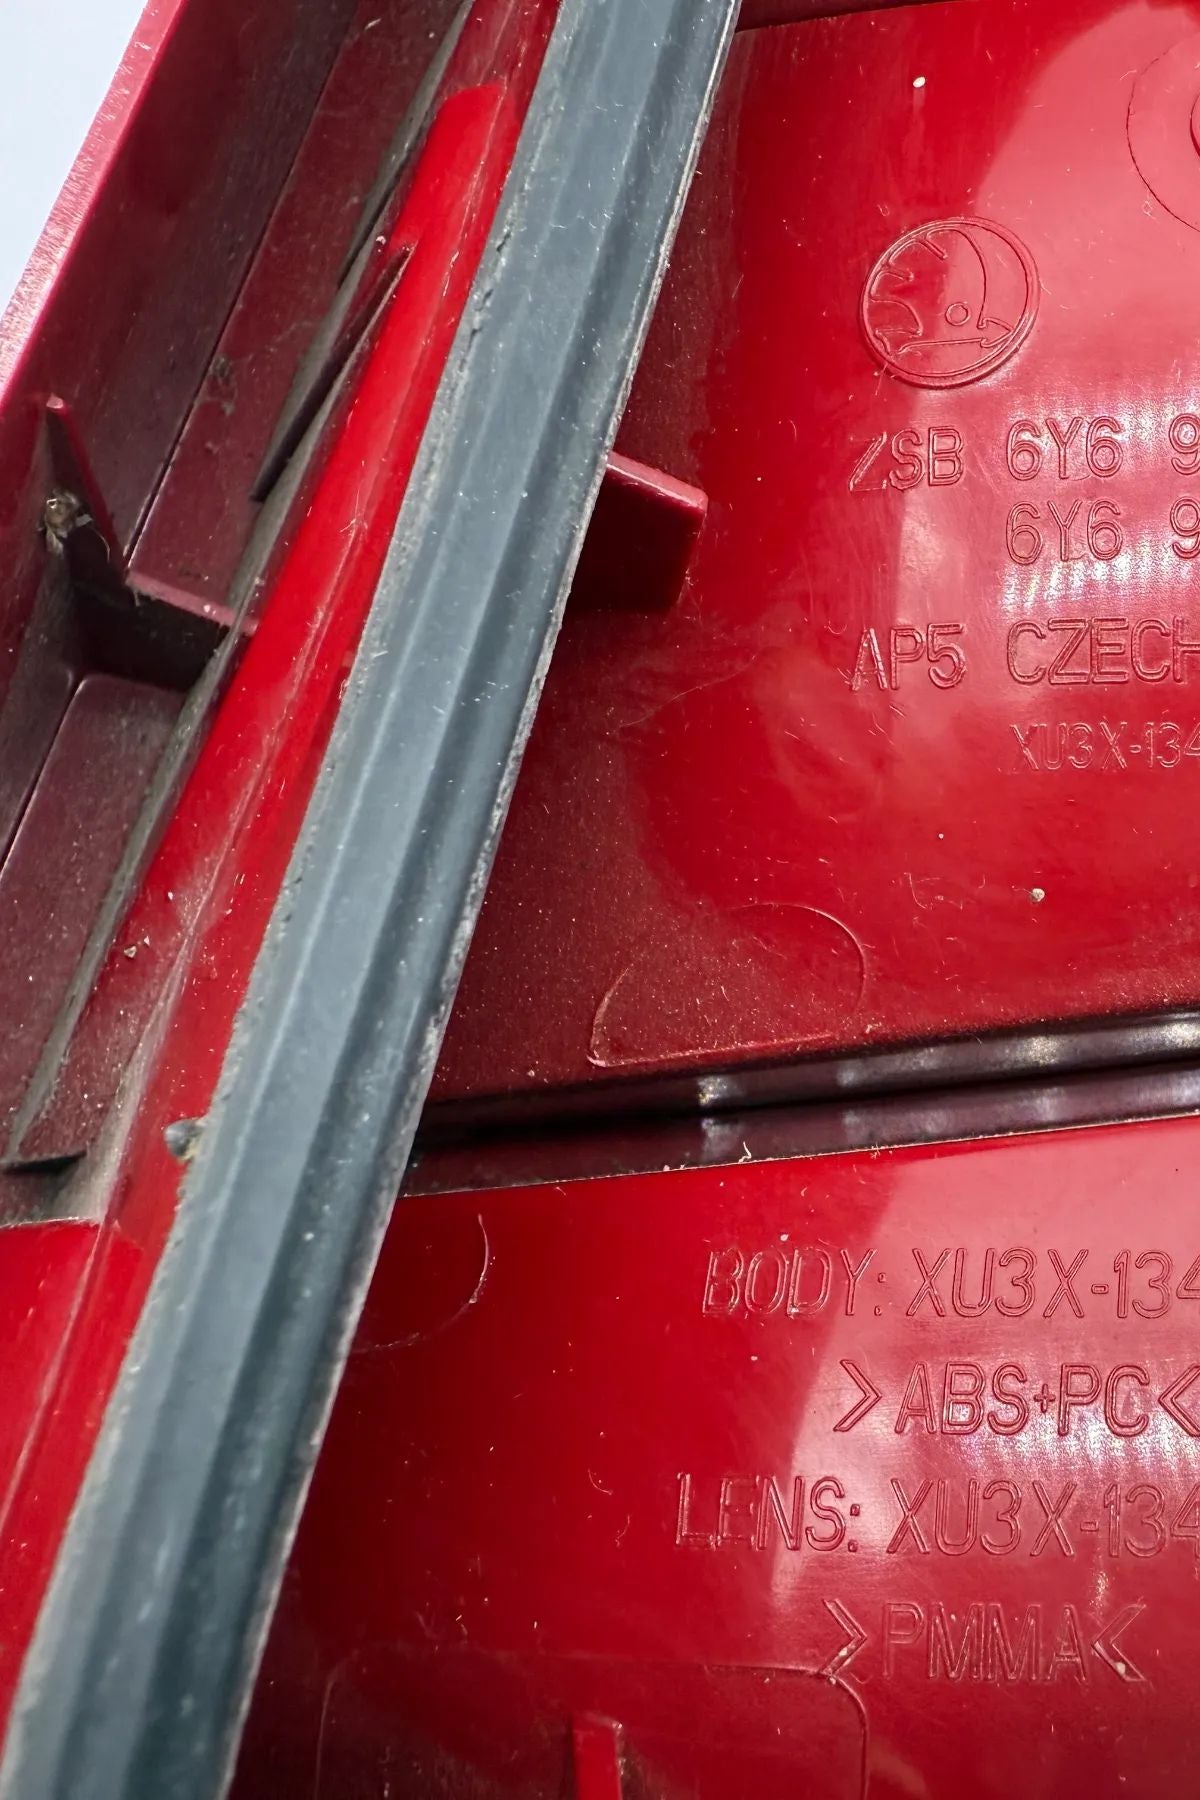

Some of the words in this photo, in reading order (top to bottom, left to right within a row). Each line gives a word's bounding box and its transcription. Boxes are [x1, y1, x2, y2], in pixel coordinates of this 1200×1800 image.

[848, 425, 965, 493] ZSB
[1006, 416, 1123, 481] 6Y6
[1006, 497, 1123, 565] 6Y6
[851, 622, 967, 692] AP5
[702, 1246, 886, 1319] BODY:
[673, 1471, 861, 1553] LENS:
[821, 1598, 1149, 1685] >PMMA<
